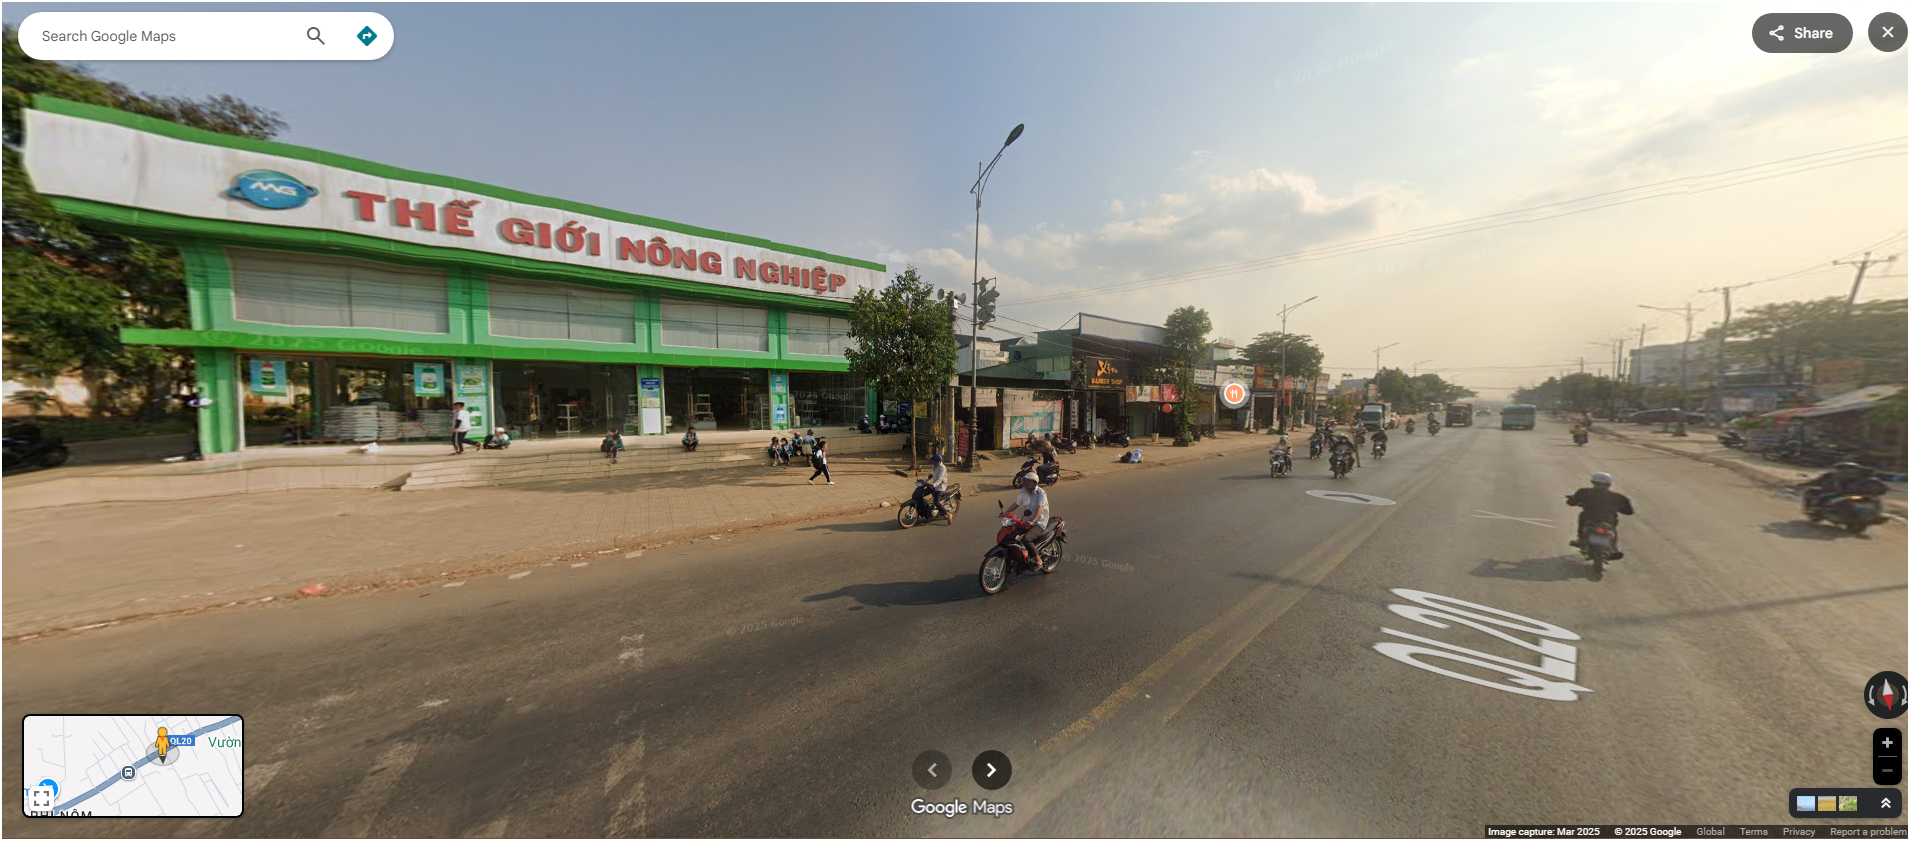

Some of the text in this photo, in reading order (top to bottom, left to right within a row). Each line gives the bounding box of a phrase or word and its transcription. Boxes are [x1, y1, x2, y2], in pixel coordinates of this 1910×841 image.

[346, 189, 847, 295] THẾ GIỚI NÔNG NGHIỆP
[1091, 377, 1110, 385] BARBER
[1372, 587, 1595, 701] QL20
